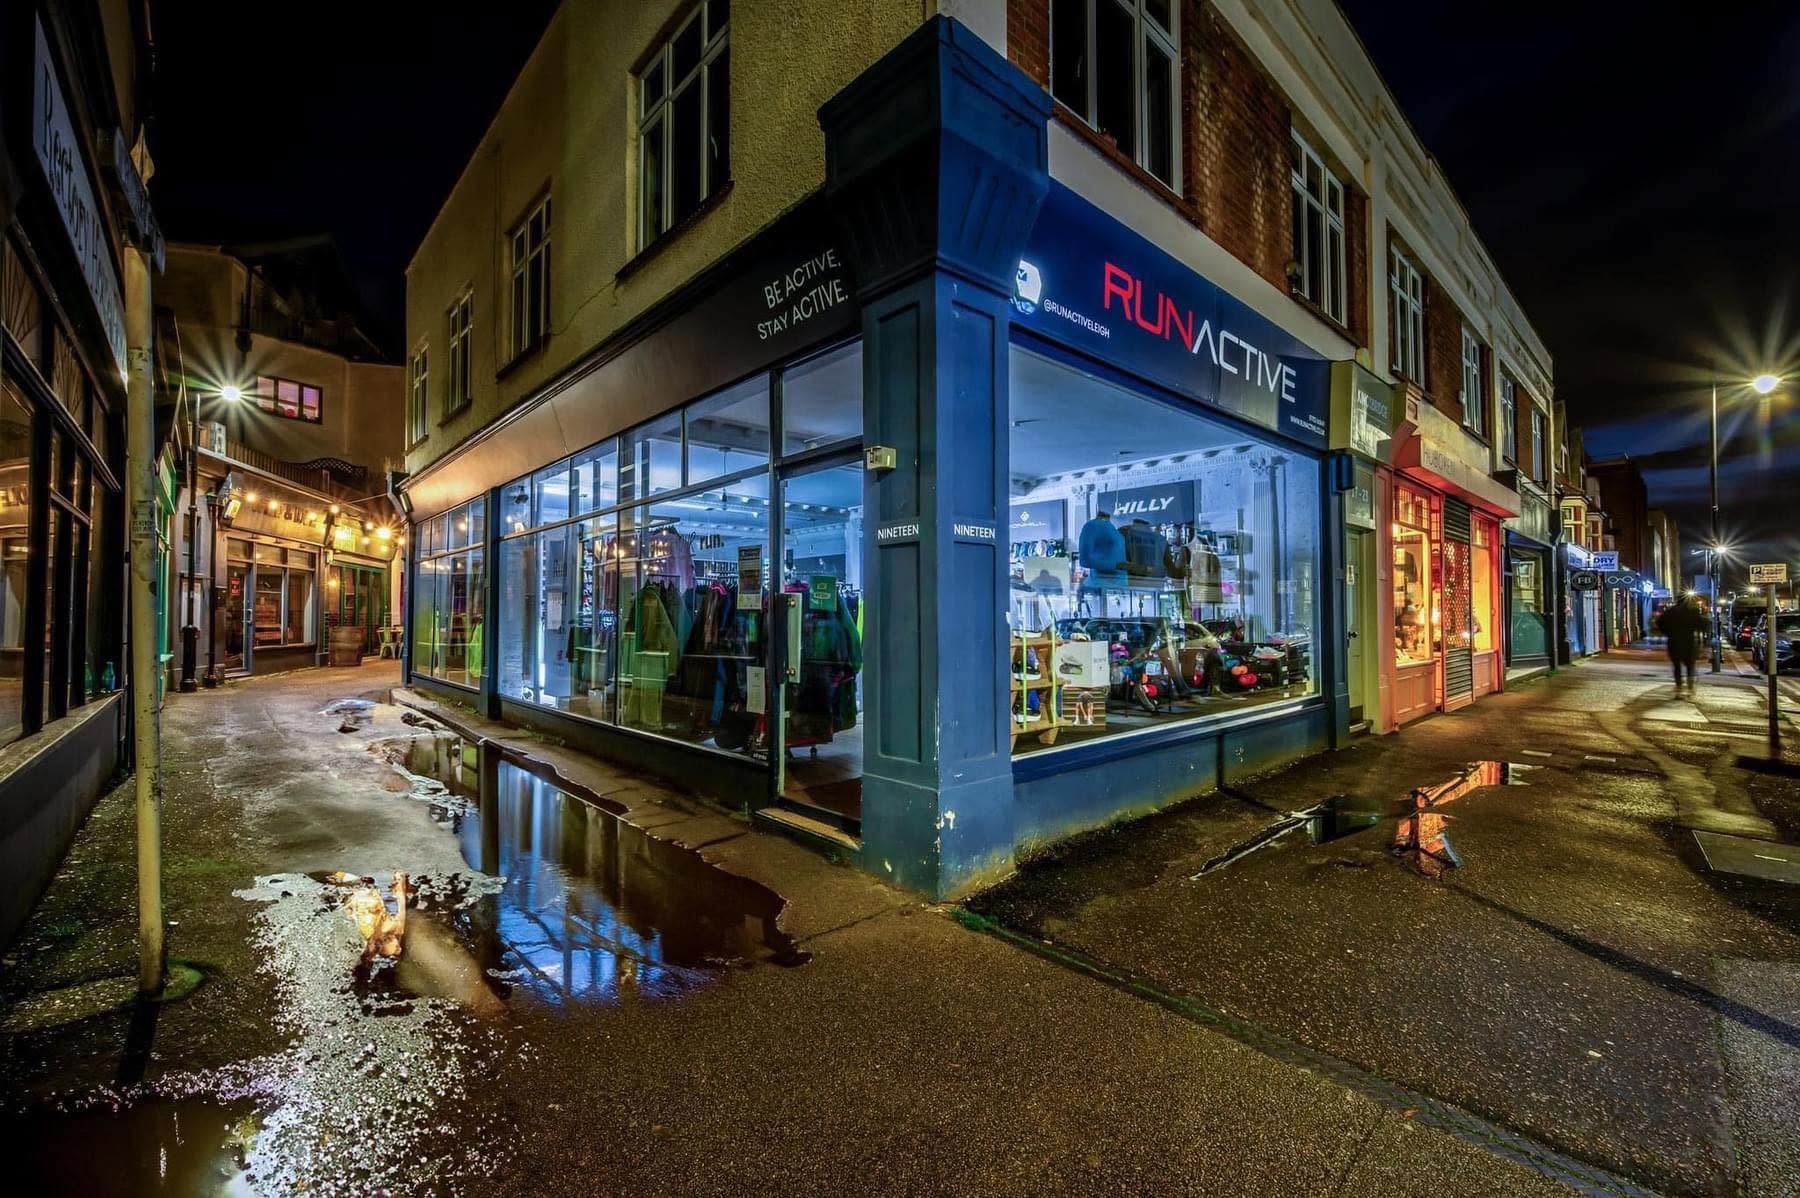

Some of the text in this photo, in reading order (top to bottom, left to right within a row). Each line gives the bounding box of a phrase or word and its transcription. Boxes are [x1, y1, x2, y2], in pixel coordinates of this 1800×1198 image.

[764, 248, 841, 309] BE ACTIVE.
[757, 279, 849, 340] STAY ACTIVE.
[1043, 298, 1110, 339] @RUNACTIVELEIGH
[1103, 261, 1297, 404] RUNACTIVE
[1113, 496, 1175, 516] HILLY
[877, 524, 919, 540] NINETEEN
[954, 524, 996, 539] NINETEEN
